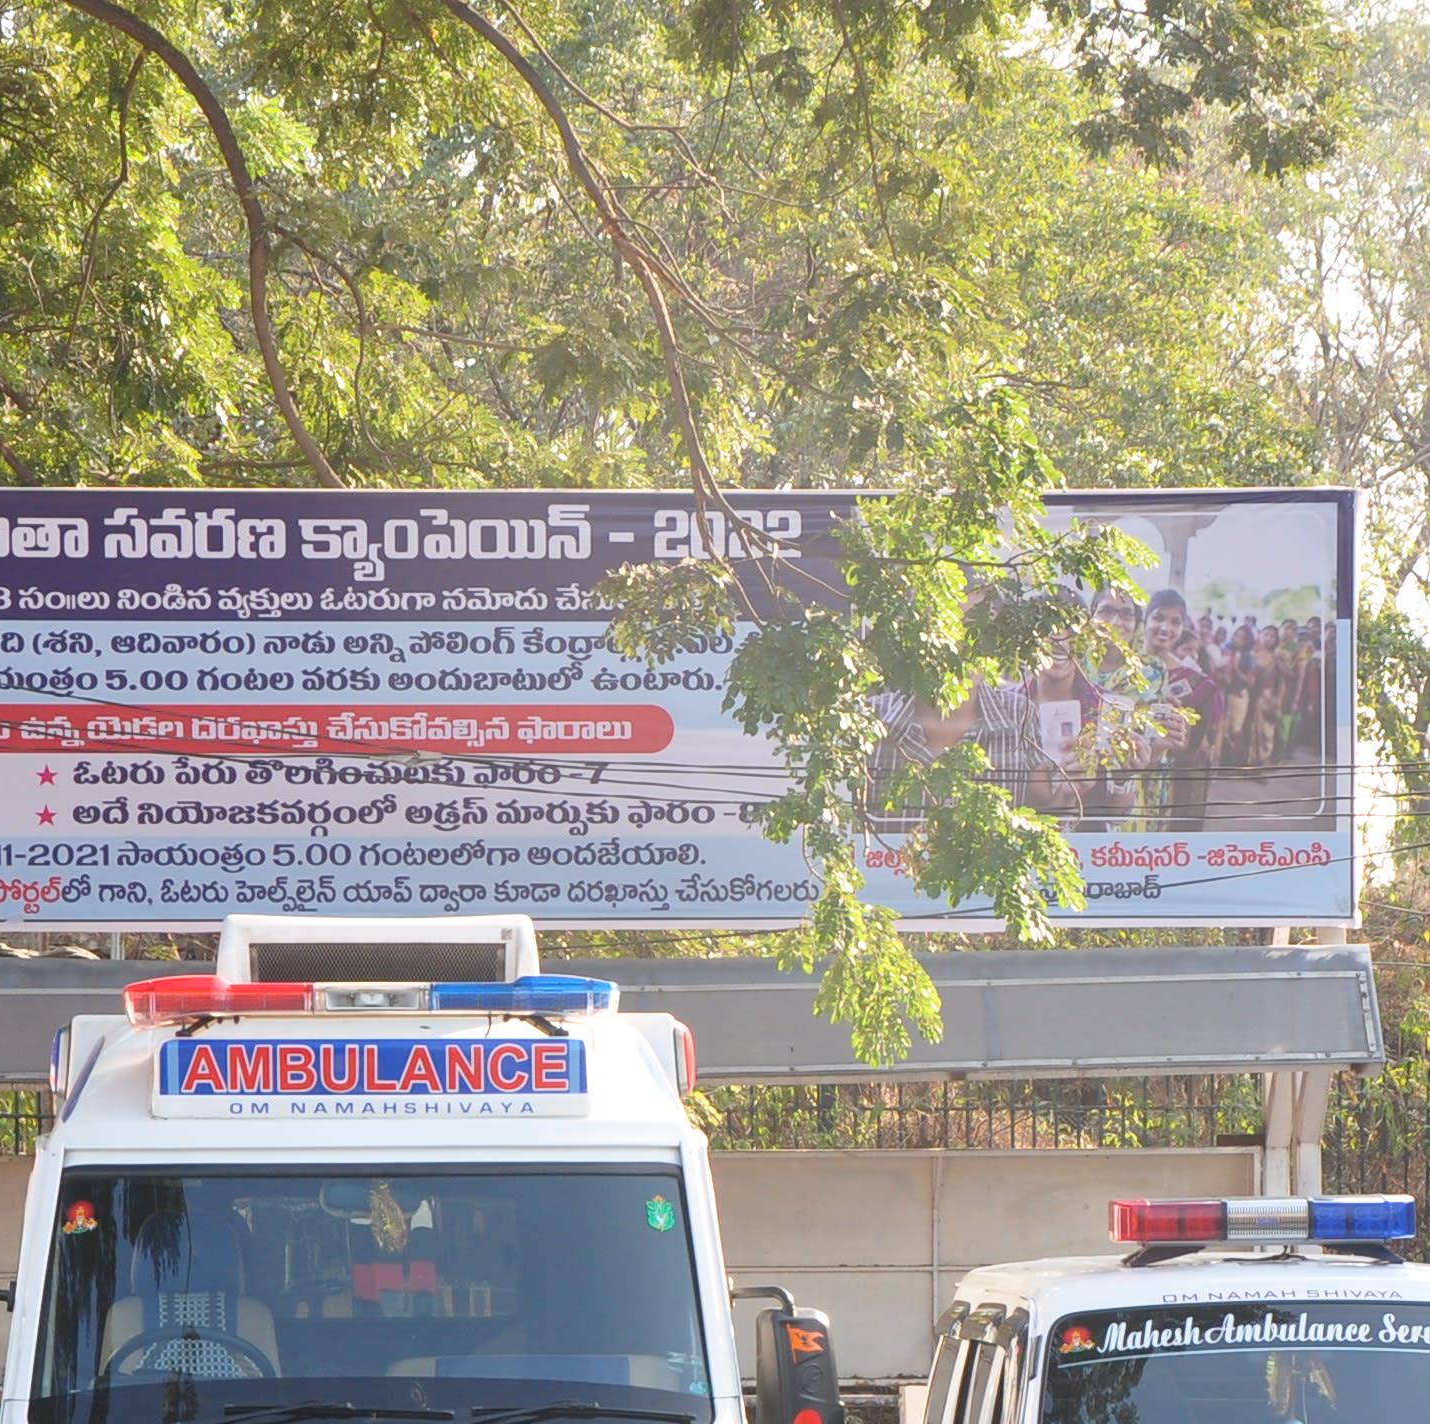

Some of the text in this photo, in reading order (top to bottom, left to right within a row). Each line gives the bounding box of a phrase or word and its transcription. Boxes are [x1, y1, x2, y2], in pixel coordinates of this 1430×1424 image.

[104, 507, 286, 560] సవరణ
[653, 509, 802, 559] 2022
[117, 583, 212, 611] నిండిన
[218, 586, 313, 619] వ్యక్తులు
[320, 586, 436, 611] ఓటరుగా
[442, 587, 548, 611] నమోదు
[32, 629, 103, 658] (శని,
[110, 631, 256, 656] ఆదివారం)
[263, 631, 335, 655] నాడు
[343, 632, 407, 663] అన్ని
[409, 626, 515, 655] పోలింగ్
[105, 669, 188, 692] 5.00
[197, 668, 294, 692] గంటల
[302, 668, 380, 692] వరకు
[387, 661, 583, 692] అందుబాటులో
[591, 665, 723, 692] ఉంటారు.
[517, 716, 632, 743] ఫారాలు
[72, 760, 165, 786] ఓటరు
[175, 756, 237, 786] పేరు
[72, 796, 130, 826] అదే
[136, 793, 399, 838] నియోజకవర్గంలో
[404, 796, 488, 831] అడ్రస్
[496, 799, 620, 836] మార్పుకు
[627, 801, 715, 829] ఫారం
[116, 840, 266, 873] సాయంత్రం
[272, 843, 352, 867] 5.00
[359, 838, 520, 866] గంటలలోగా
[1091, 841, 1190, 872] కమీషనర్
[98, 877, 152, 905] గాని,
[160, 877, 228, 903] ఓటరు
[343, 876, 416, 904] యాప్
[419, 881, 487, 912] ద్వారా
[494, 879, 560, 905] కూడా
[567, 878, 669, 911] దరఖాస్తు
[182, 1044, 569, 1093] AMBULANCE
[229, 1102, 270, 1114] OM
[1163, 1289, 1402, 1303] OM NAMAH SHIVAYA
[1095, 1313, 1203, 1354] Mahesh
[1203, 1312, 1374, 1346] Ambulance
